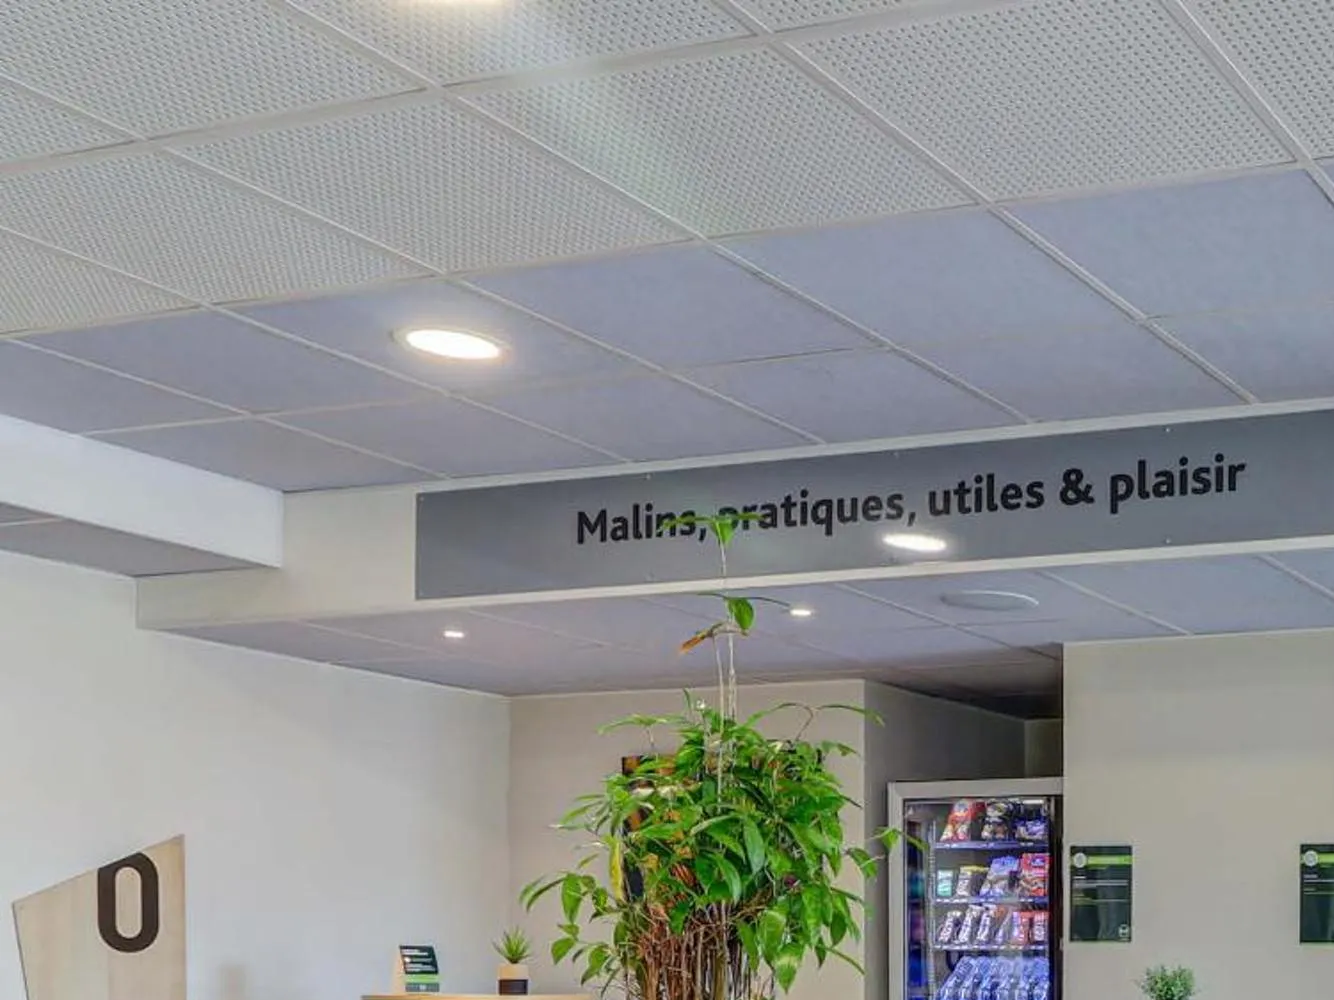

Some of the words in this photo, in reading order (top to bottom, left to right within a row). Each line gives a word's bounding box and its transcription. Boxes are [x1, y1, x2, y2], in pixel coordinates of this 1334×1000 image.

[576, 502, 707, 544] Malins,
[928, 472, 1045, 516] utiles
[1059, 467, 1095, 506] &
[1109, 453, 1246, 514] plaisir
